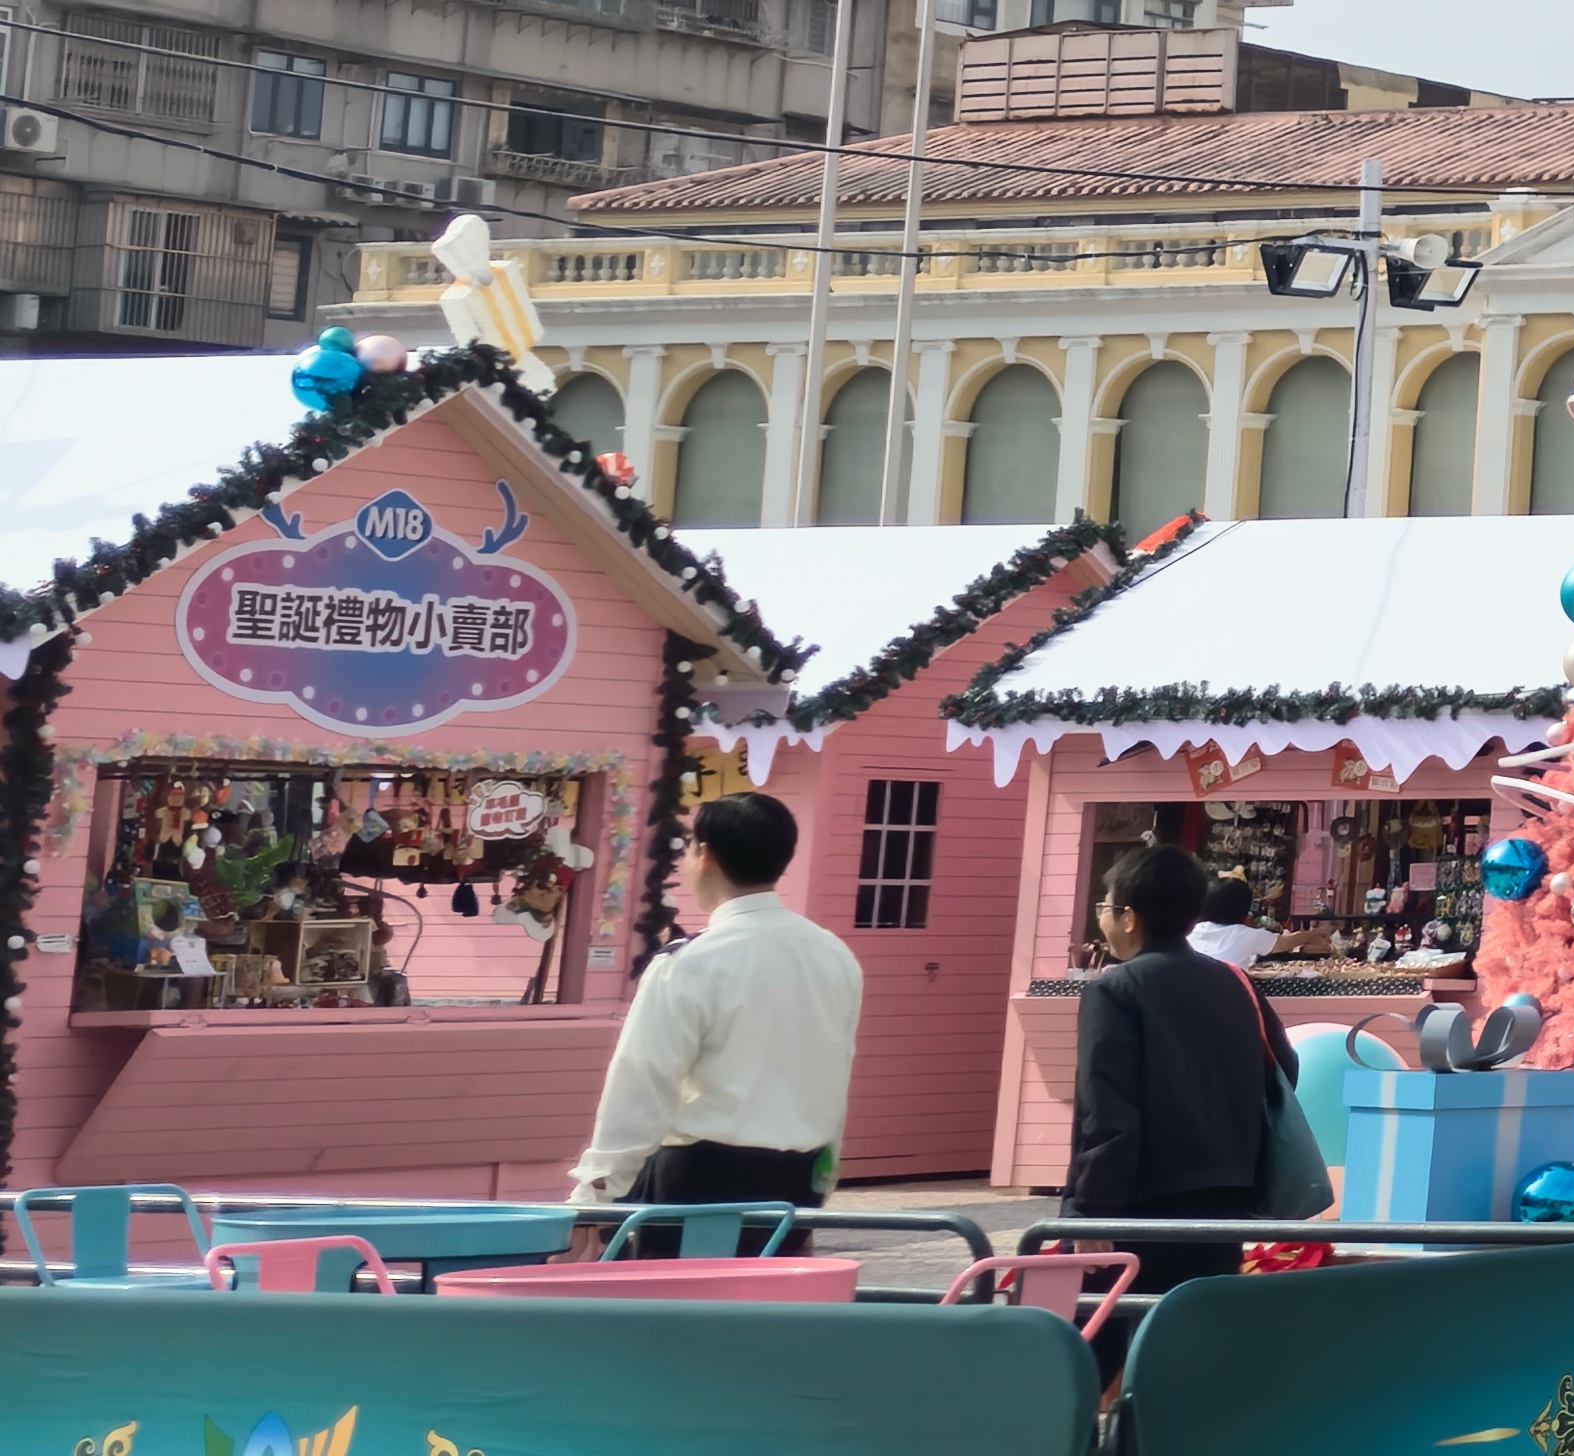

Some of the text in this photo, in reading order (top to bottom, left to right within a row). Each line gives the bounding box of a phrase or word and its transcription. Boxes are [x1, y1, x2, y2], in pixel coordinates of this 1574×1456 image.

[365, 505, 424, 540] M18
[232, 589, 531, 655] 聖誕禮物小賣部
